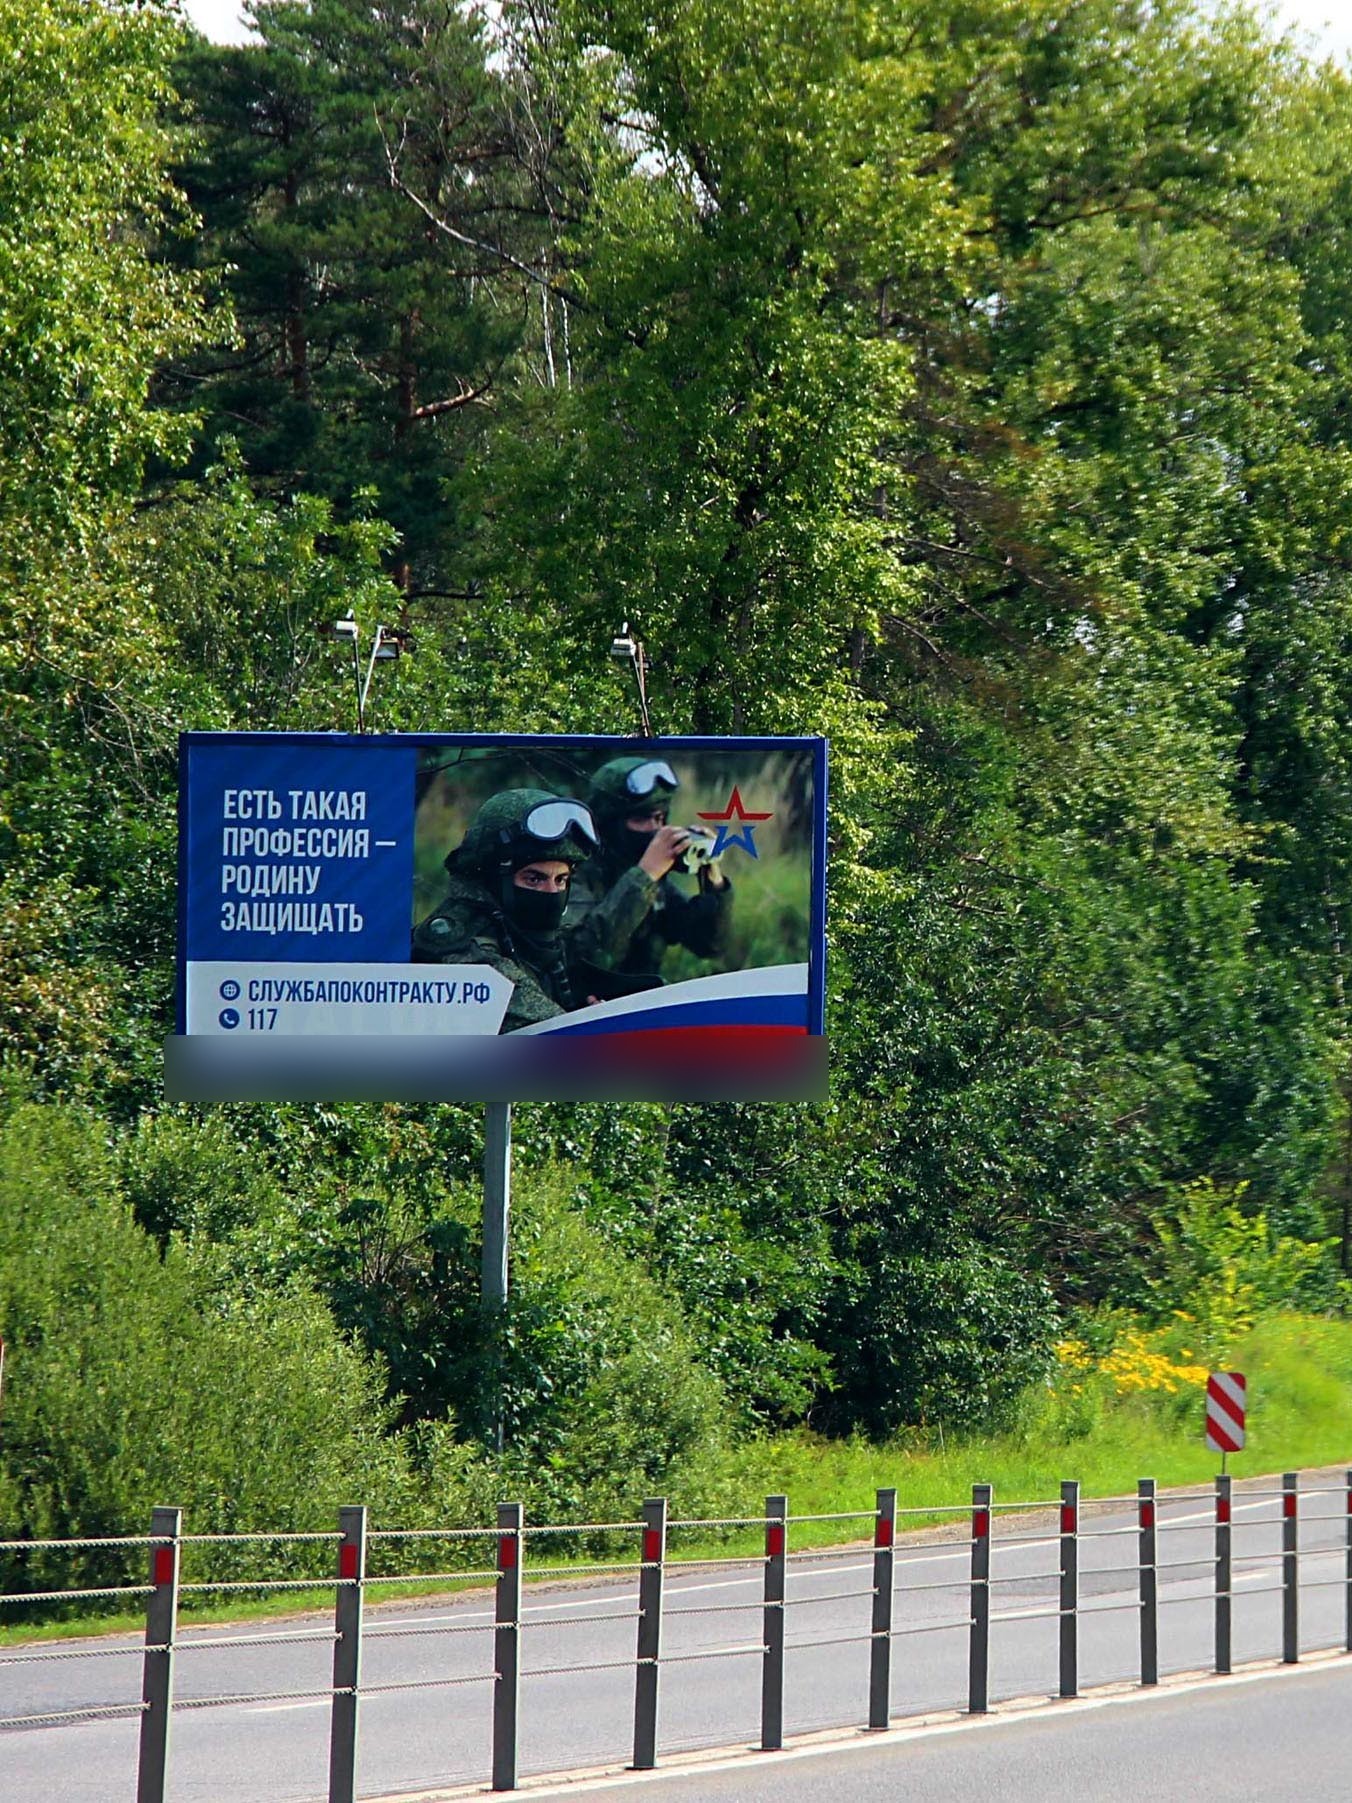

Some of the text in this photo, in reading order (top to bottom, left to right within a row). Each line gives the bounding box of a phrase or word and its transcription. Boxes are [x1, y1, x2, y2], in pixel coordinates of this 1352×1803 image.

[223, 789, 366, 820] ЕСТЬ ТАКАЯ
[222, 827, 370, 858] ПРОФЕССИЯ
[221, 864, 321, 897] РОДИНУ
[220, 902, 363, 935] ЗАЩИЩАТЬ
[248, 980, 490, 1004] СЛУЖБАПОКОНТРАКТУ.РФ
[248, 1008, 278, 1030] 117
